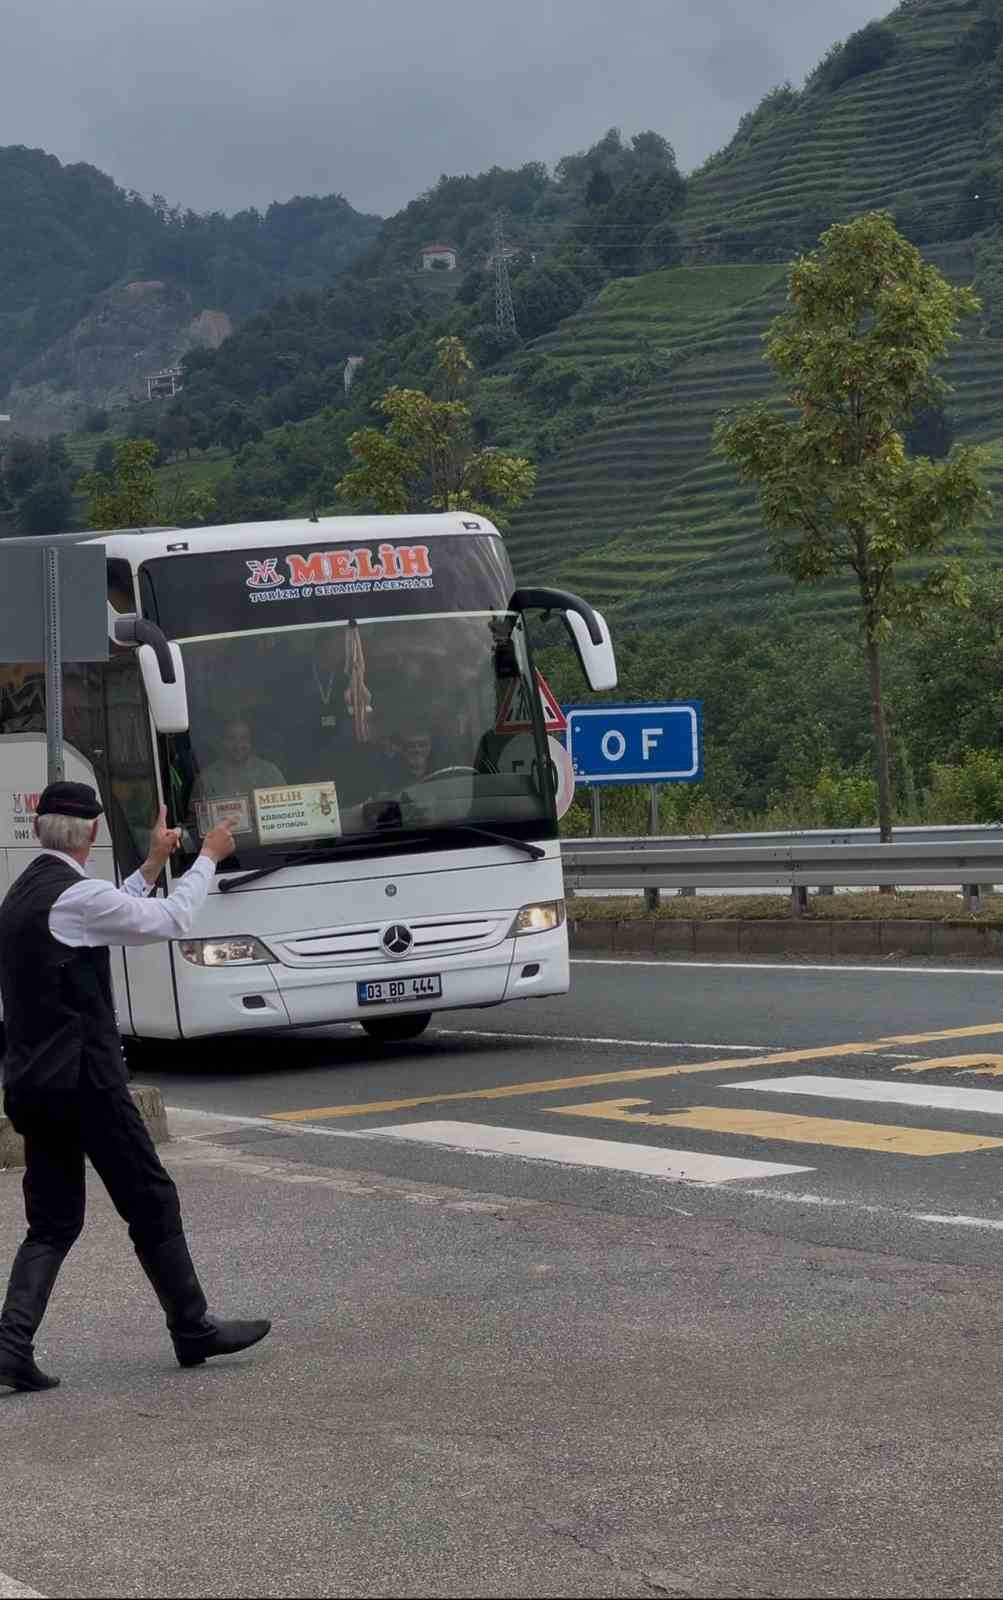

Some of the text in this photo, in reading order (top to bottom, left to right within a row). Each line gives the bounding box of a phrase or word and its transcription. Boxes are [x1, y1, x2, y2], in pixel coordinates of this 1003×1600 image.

[367, 978, 434, 999] 03 BD 444
